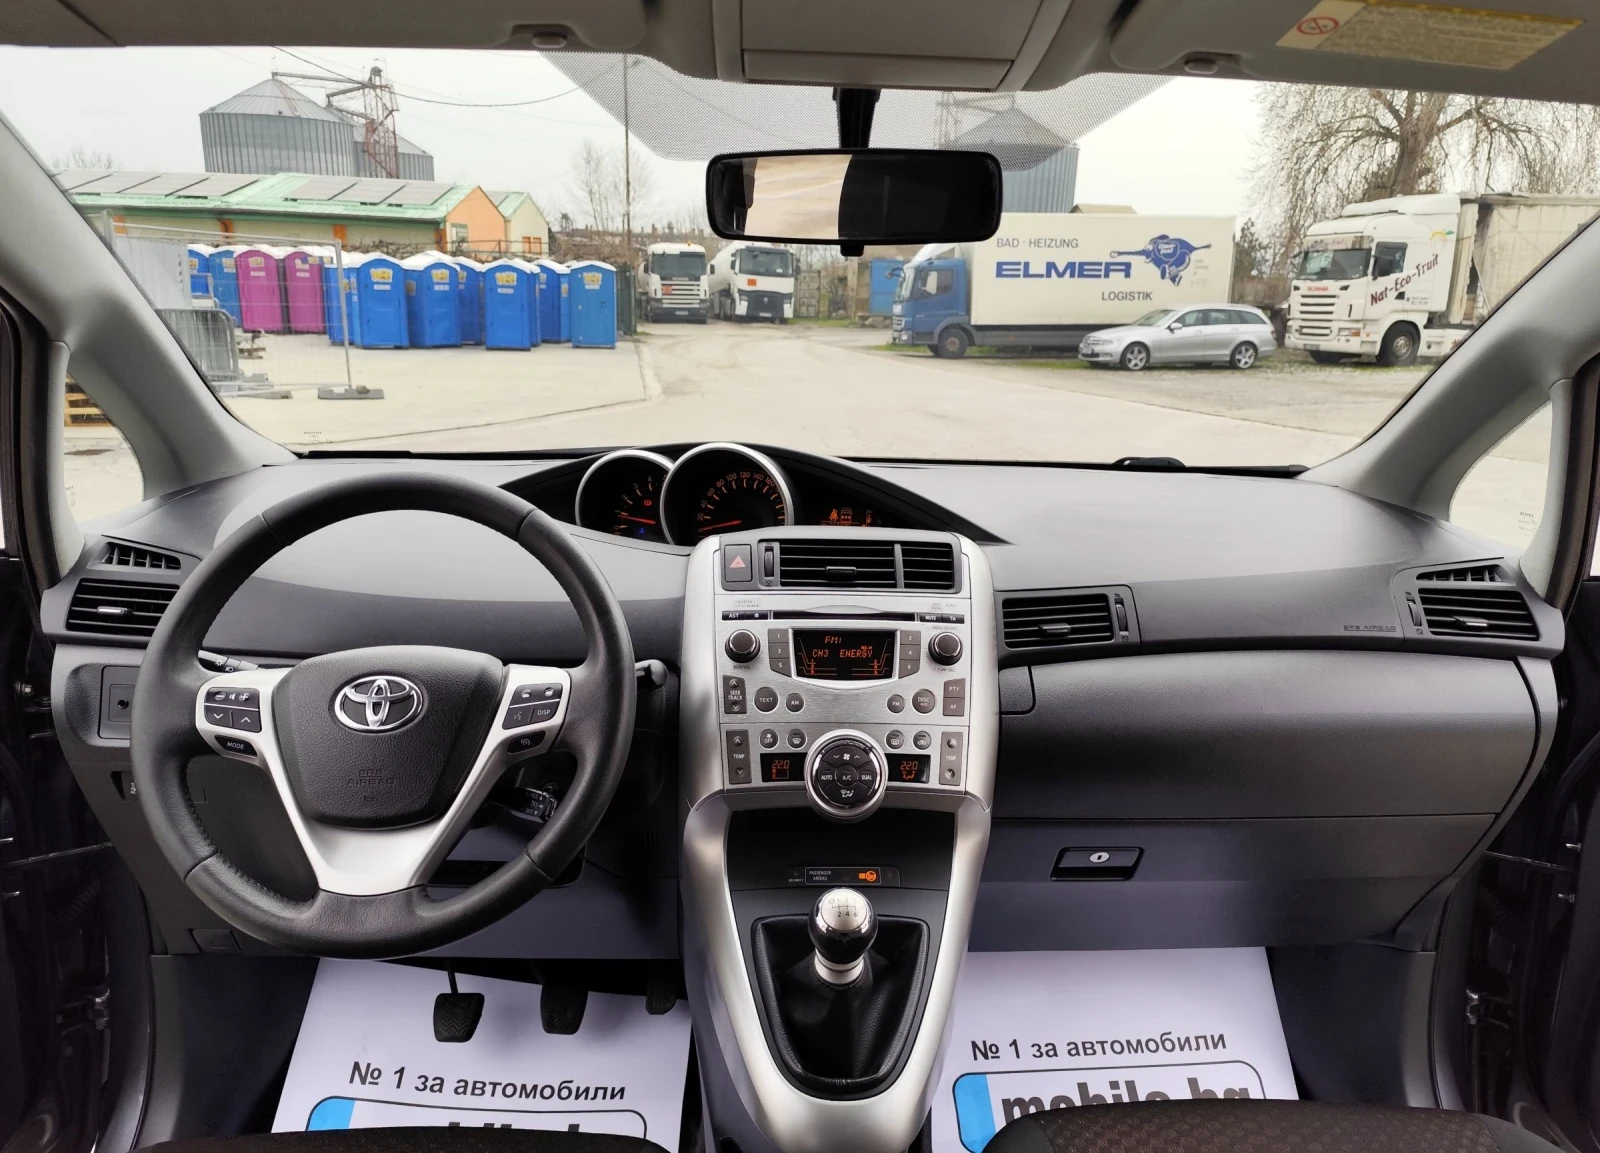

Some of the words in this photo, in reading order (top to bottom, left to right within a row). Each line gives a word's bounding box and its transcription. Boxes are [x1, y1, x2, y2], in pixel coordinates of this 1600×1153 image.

[996, 238, 1020, 248] BAD
[1028, 238, 1079, 249] HEIZUNG
[995, 261, 1132, 278] ELMER
[1101, 291, 1153, 301] LOGISTIK
[726, 473, 737, 481] 100
[753, 472, 764, 480] 140
[715, 478, 725, 487] 80
[765, 477, 776, 487] 160
[707, 487, 715, 496] 60
[700, 499, 708, 509] 40
[697, 513, 704, 521] 20
[812, 649, 829, 658] CH3
[839, 649, 873, 658] ENERGY
[227, 741, 244, 749] MODE
[970, 1038, 1001, 1061] №
[1009, 1038, 1021, 1060] 1
[1031, 1042, 1059, 1059] за
[1066, 1031, 1227, 1057] автомобили
[348, 1060, 382, 1086] №
[393, 1066, 406, 1090] 1
[414, 1074, 445, 1095] за
[453, 1078, 627, 1102] автомобили
